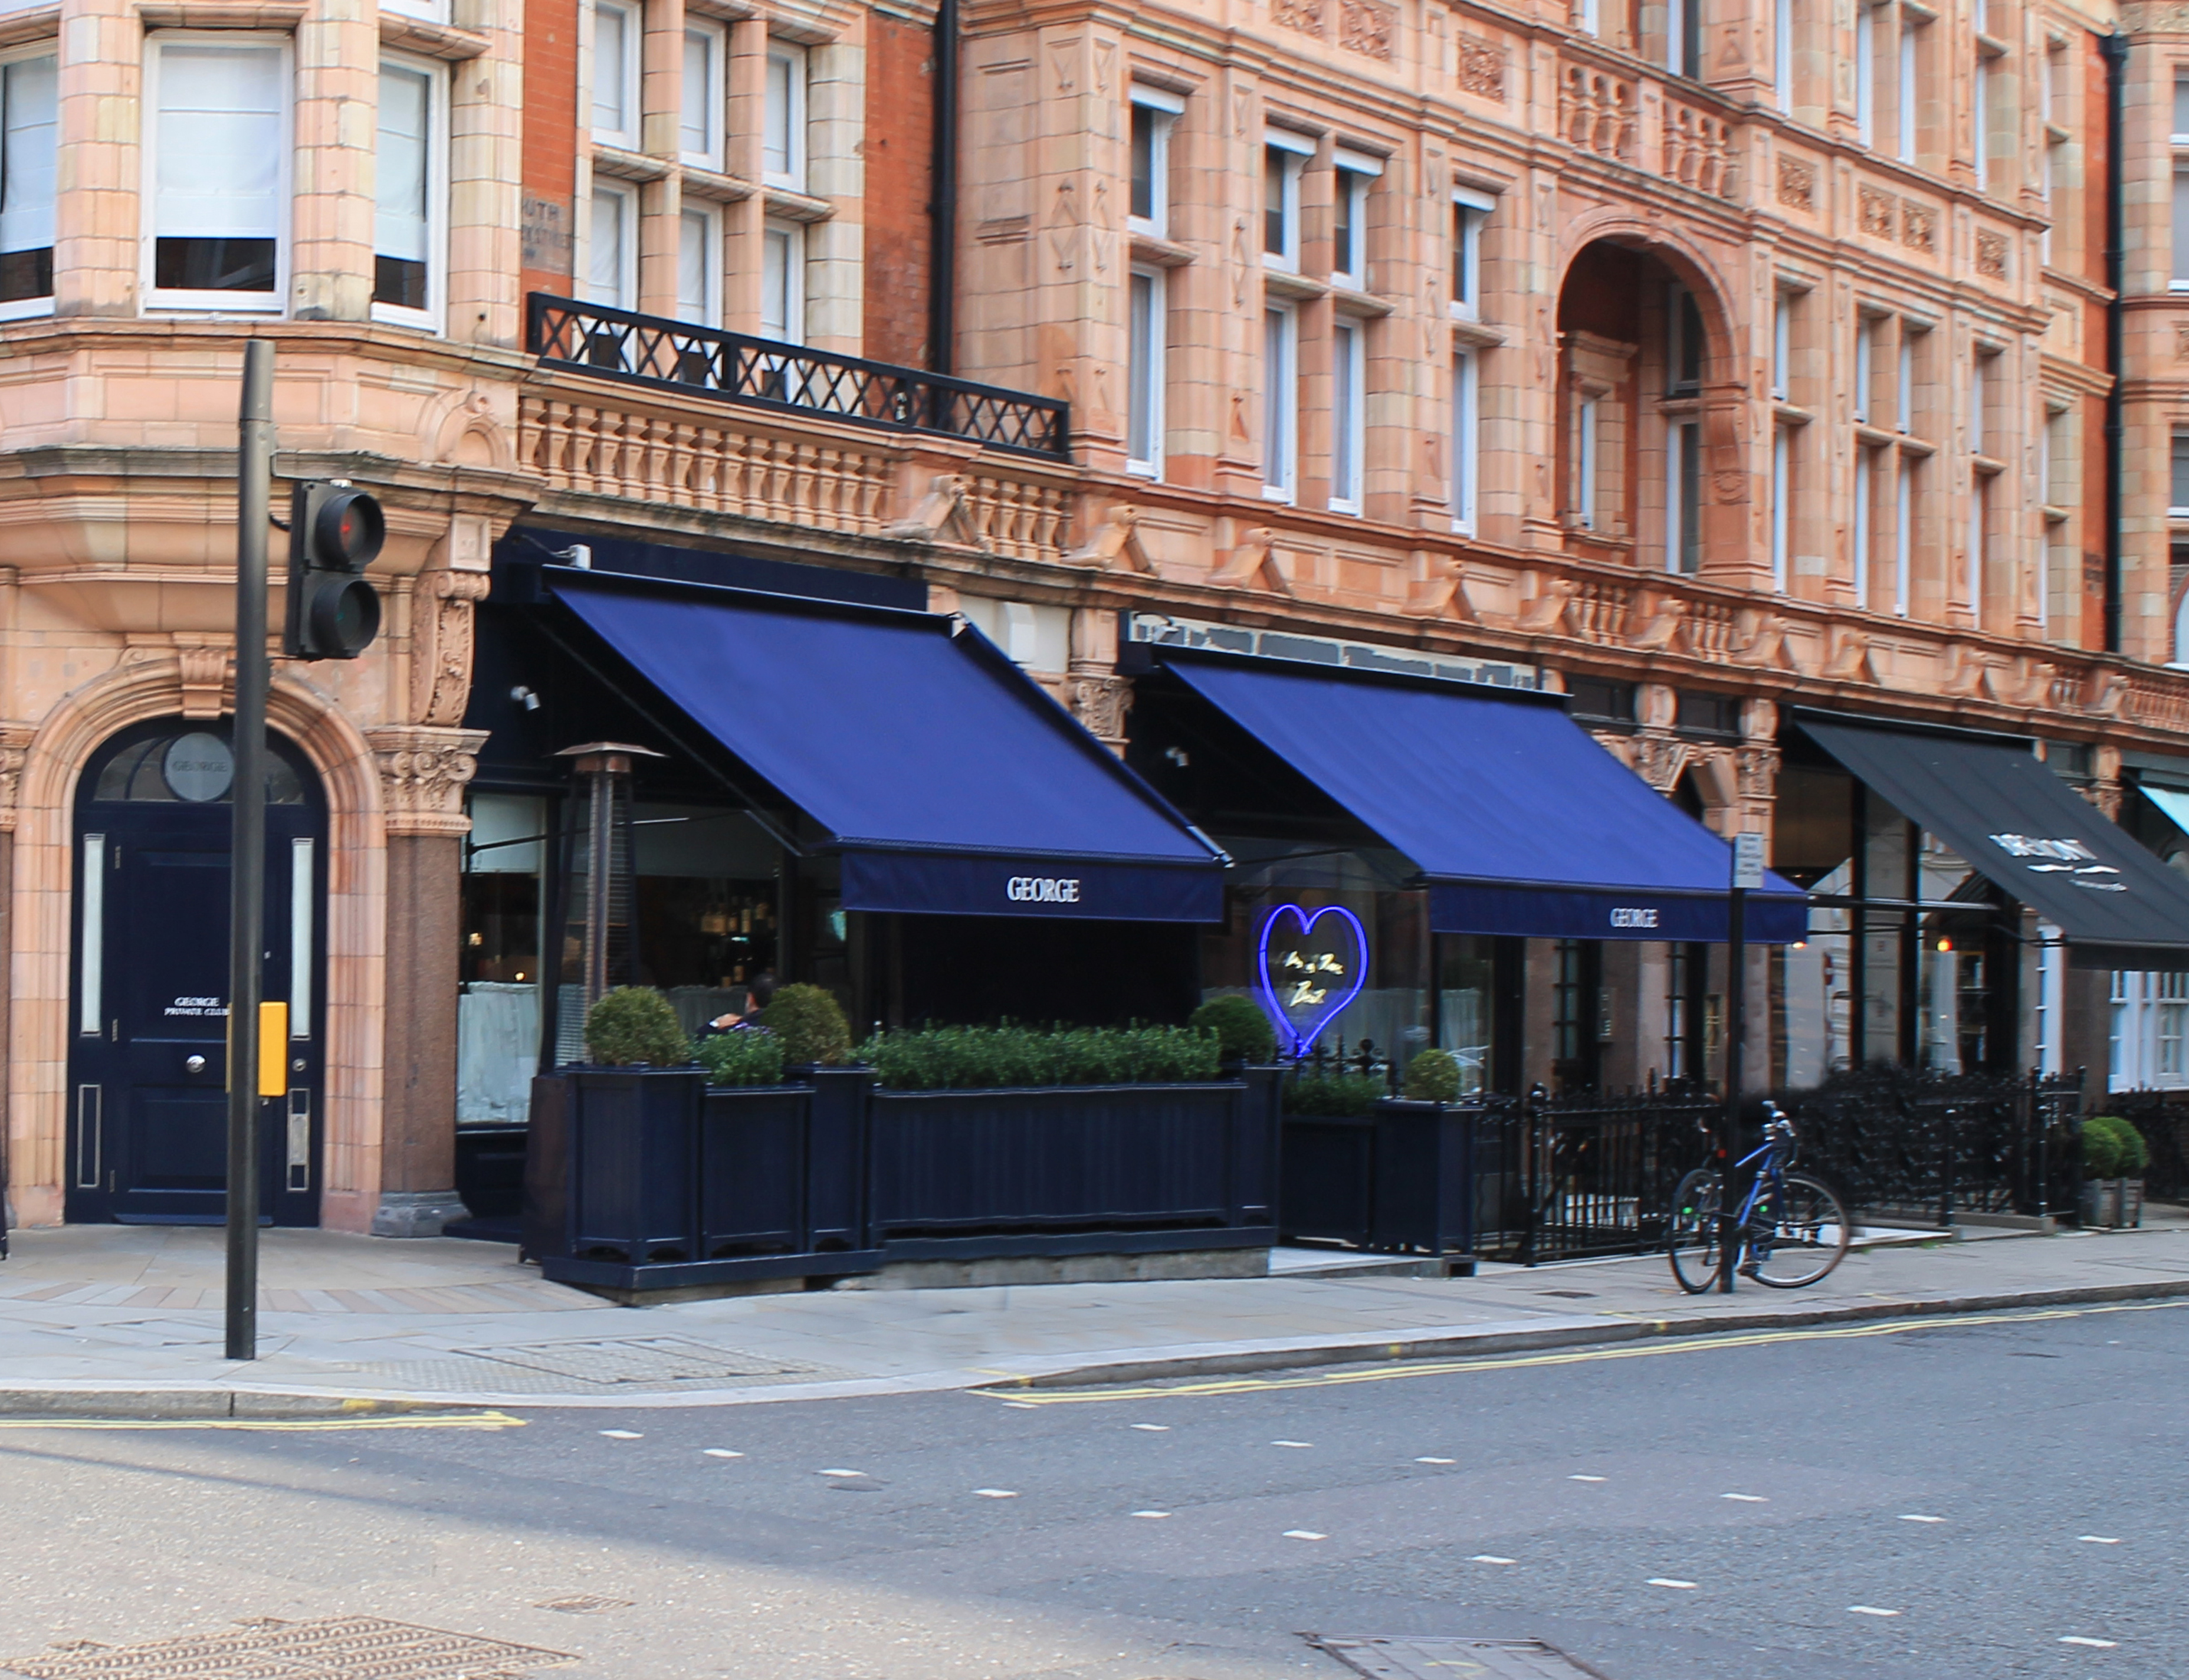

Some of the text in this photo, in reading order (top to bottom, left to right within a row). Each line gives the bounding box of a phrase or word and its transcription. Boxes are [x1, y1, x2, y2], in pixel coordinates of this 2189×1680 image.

[1007, 877, 1080, 903] GEORGE
[1610, 908, 1658, 928] GEORGE
[174, 996, 220, 1007] GEORGE
